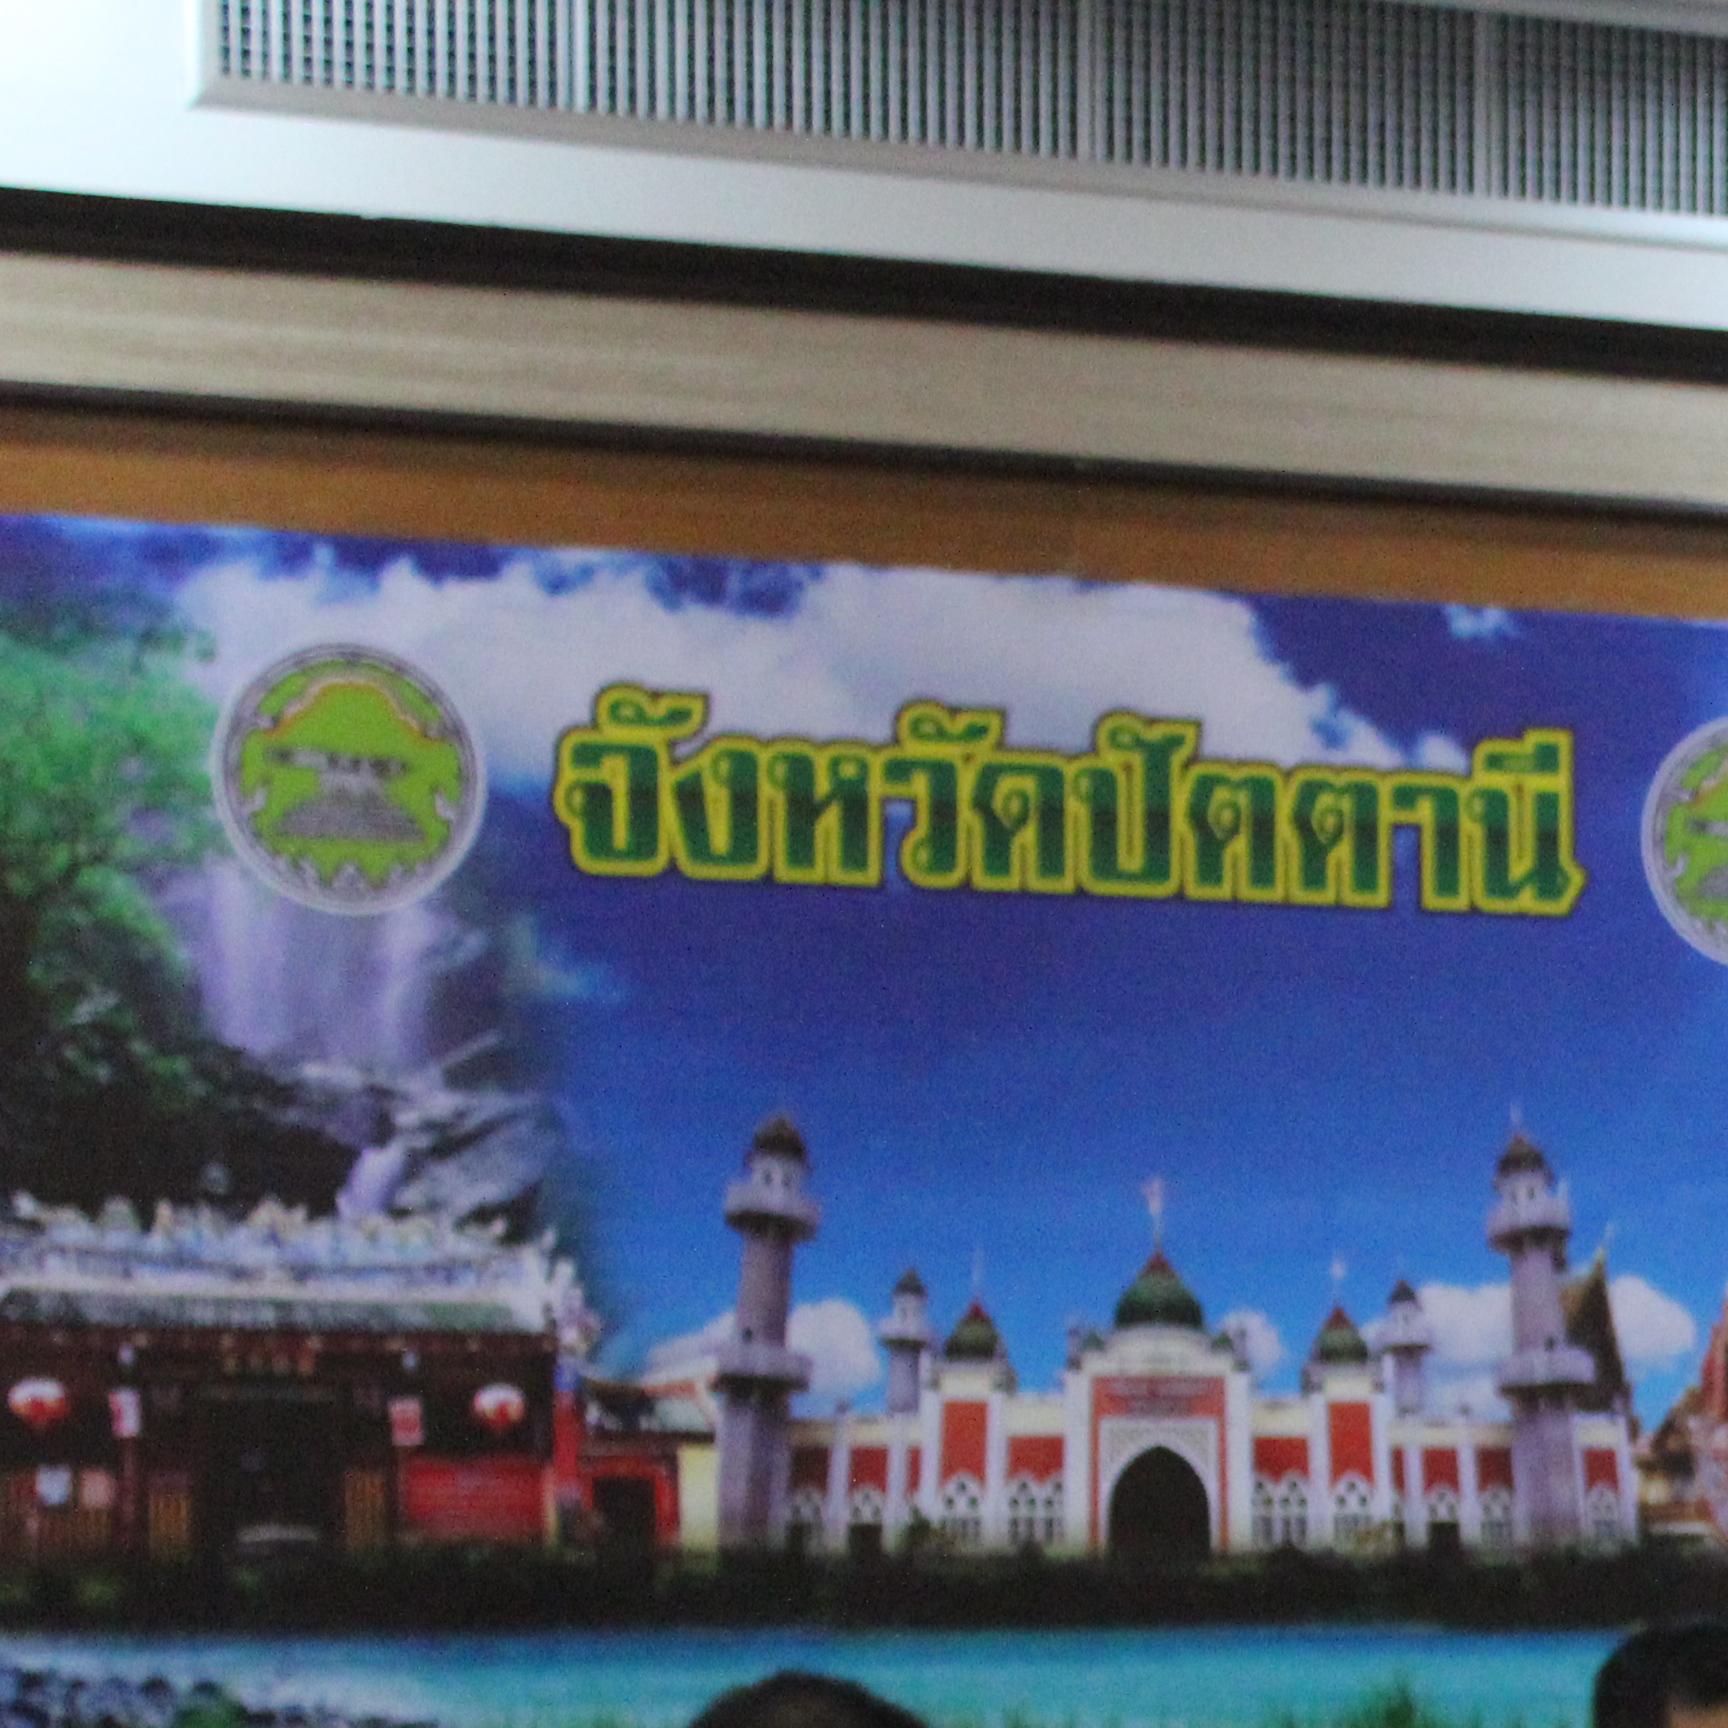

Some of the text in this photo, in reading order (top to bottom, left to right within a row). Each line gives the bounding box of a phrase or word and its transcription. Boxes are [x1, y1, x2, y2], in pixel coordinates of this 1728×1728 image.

[554, 683, 1586, 916] จังหวัดปัตตานี
